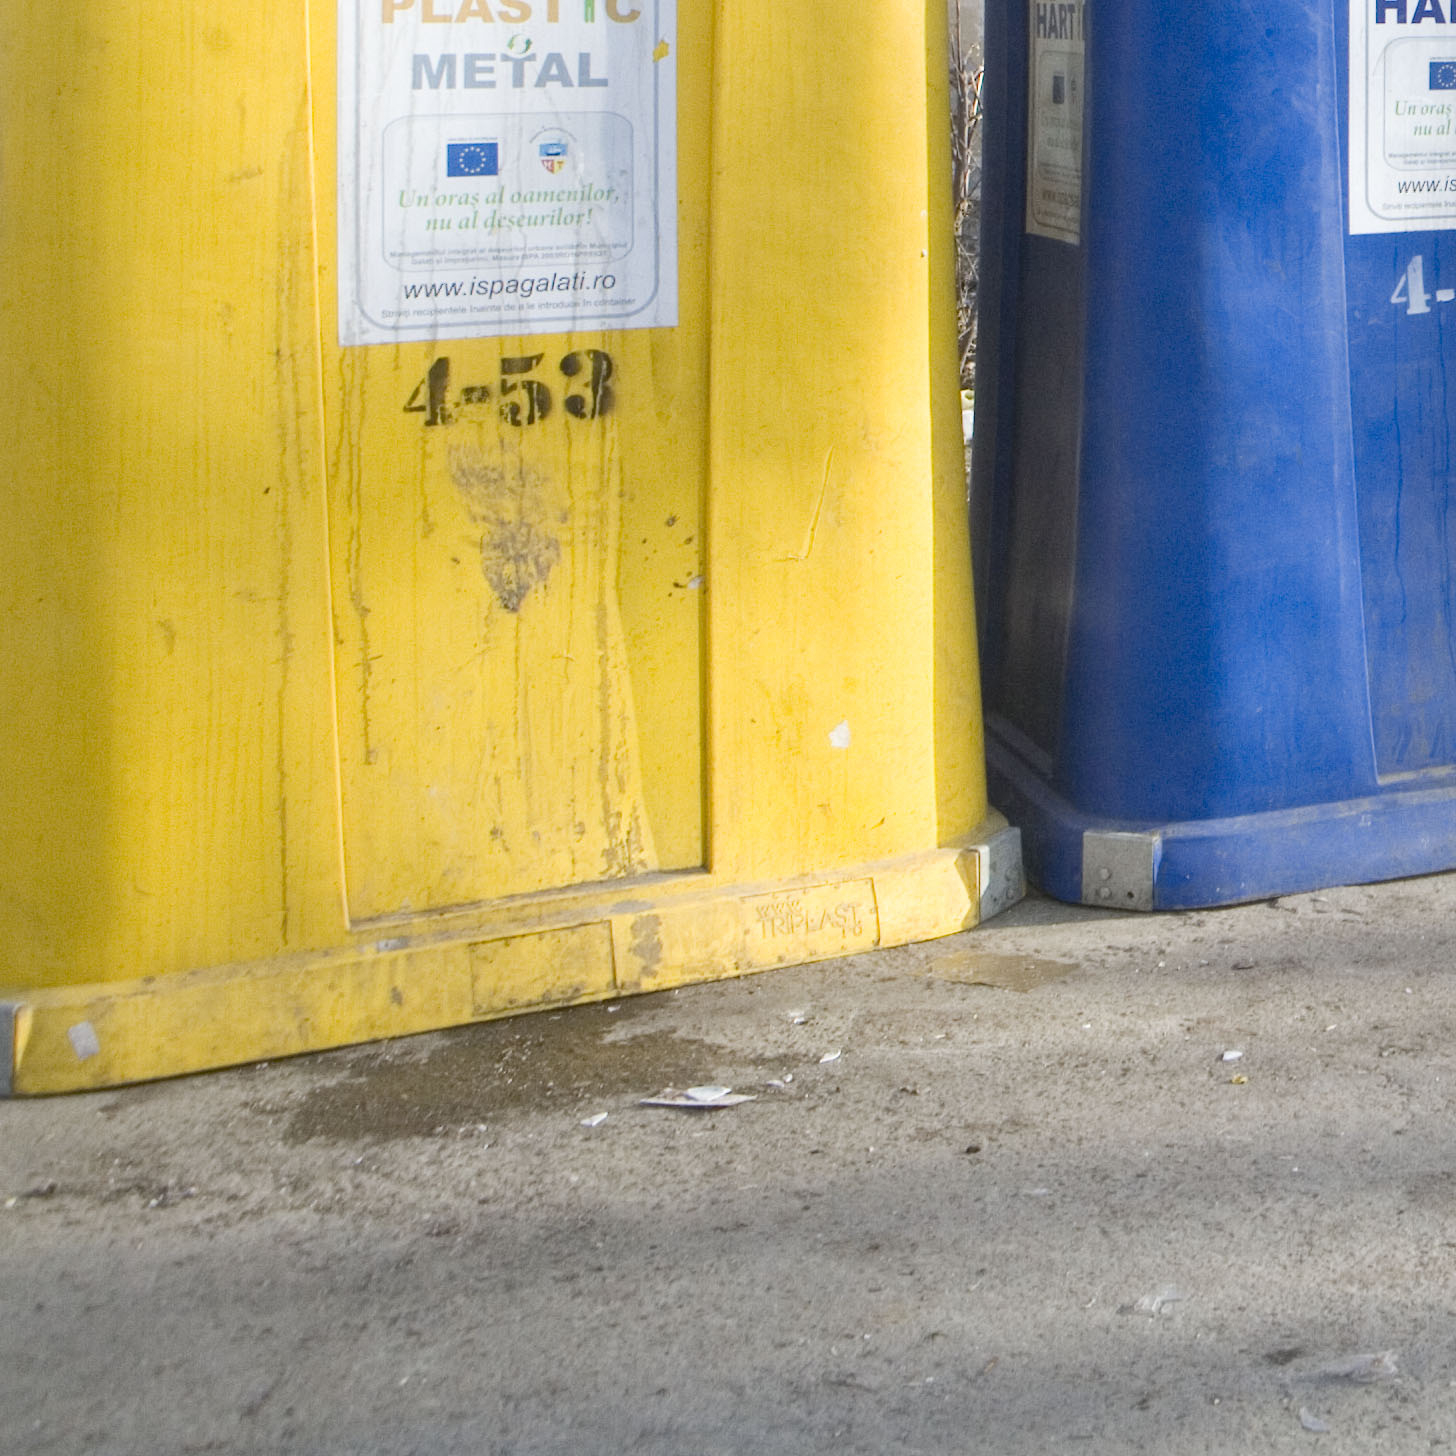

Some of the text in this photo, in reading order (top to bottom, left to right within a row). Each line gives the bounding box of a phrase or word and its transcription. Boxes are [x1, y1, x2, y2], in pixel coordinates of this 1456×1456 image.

[412, 52, 609, 90] METAL
[1395, 100, 1416, 116] Un
[1413, 124, 1432, 137] nu
[1436, 118, 1451, 136] al
[399, 190, 430, 208] Un
[485, 184, 505, 205] al
[509, 182, 620, 205] oamenilor,
[424, 217, 452, 231] nu
[458, 209, 479, 230] al
[403, 271, 617, 300] www.ispagalati.ro
[402, 348, 616, 428] 4-53
